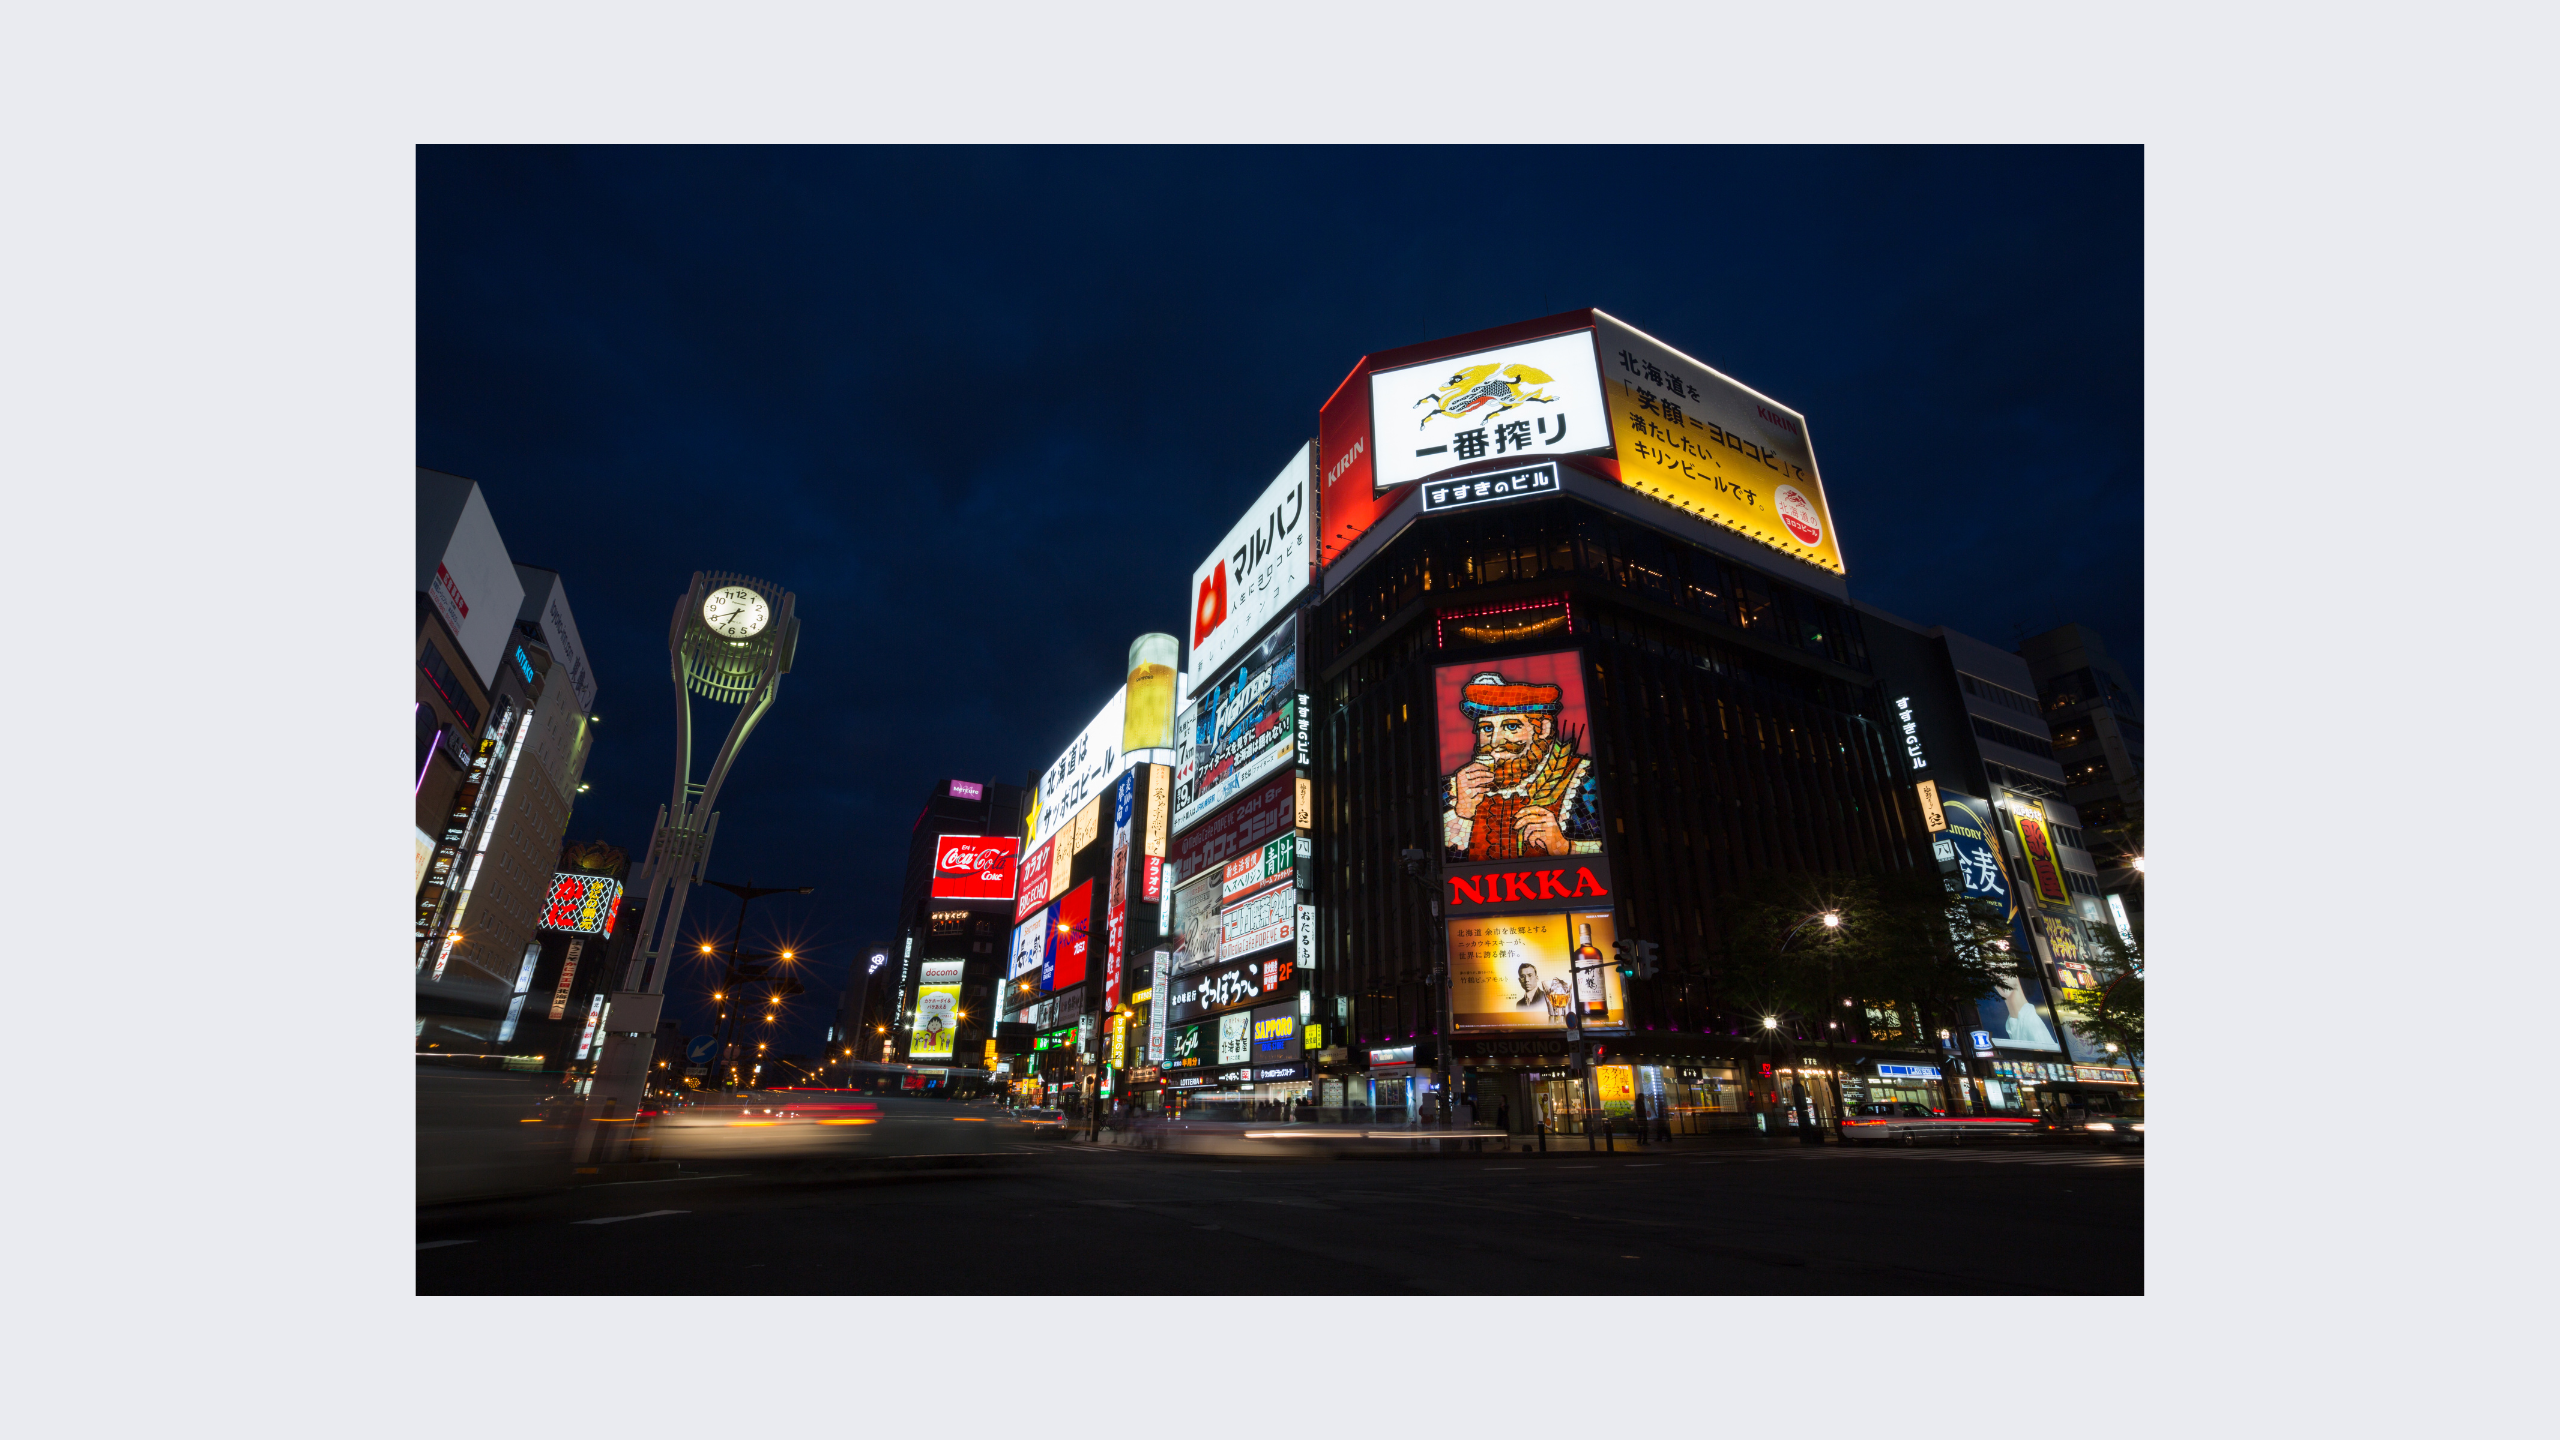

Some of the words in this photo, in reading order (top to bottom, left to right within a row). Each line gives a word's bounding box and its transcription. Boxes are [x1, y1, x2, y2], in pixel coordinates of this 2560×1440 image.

[1619, 349, 1700, 403] 北海道を
[1756, 404, 1798, 436] KIRIN
[1415, 412, 1568, 461] 一番搾り
[1629, 411, 1721, 468] 満たしたい、
[1327, 436, 1364, 488] KIRIN
[1431, 471, 1549, 504] すすきのビル
[1635, 440, 1765, 512] キリンビールです。
[1778, 501, 1818, 527] 北海道の
[1232, 480, 1303, 586] マルハン
[1231, 533, 1303, 614] 人生にヨロコビを
[709, 604, 717, 612] 9
[715, 596, 726, 605] 10
[724, 591, 734, 600] 11
[736, 590, 748, 600] 12
[755, 604, 762, 612] 2
[710, 614, 718, 622] 8
[719, 622, 726, 630] 7
[728, 627, 736, 635] 6
[740, 627, 748, 635] 5
[750, 622, 757, 630] 4
[1210, 663, 1274, 757] FIGHTERS
[1297, 693, 1310, 766] すすきのビル
[1895, 696, 1927, 770] すすきのビル
[1046, 732, 1089, 798] 北海道は
[1198, 726, 1257, 779] ファイターズを見ずに
[953, 785, 979, 795] Mercure
[1043, 745, 1115, 835] サッポロビール
[1236, 796, 1262, 822] 24H
[1264, 786, 1283, 805] 8F
[1173, 830, 1238, 881] ネットカフェ
[1238, 794, 1294, 849] コミック
[1945, 823, 1982, 841] UNTORY
[941, 847, 1009, 870] Coca-Cola
[1023, 846, 1050, 882] カラオケ
[1225, 851, 1258, 879] 新生活習慣
[1265, 842, 1294, 876] 青汁
[981, 870, 1003, 881] Coke
[1147, 856, 1161, 895] カラオケ
[1224, 868, 1263, 893] ヘスペリジン
[1447, 866, 1609, 906] NIKKA
[548, 876, 585, 928] かに
[1270, 887, 1295, 924] 24H
[1254, 928, 1278, 948] POPEYE
[1456, 928, 1483, 938] 北海道
[1484, 925, 1548, 937] 余市を故郷とする
[1458, 949, 1522, 960] 世界に誇る傑作。
[925, 968, 959, 977] docomo
[1279, 961, 1294, 982] 2F
[1254, 1015, 1294, 1042] SAPPORO
[1174, 1031, 1199, 1057] エイブル
[1476, 1041, 1562, 1055] SUSUKINO
[1180, 1077, 1200, 1087] LOTTERIA
[1602, 1068, 1611, 1098] スクエア
[1611, 1067, 1622, 1097] タイムズ
[1910, 1066, 1933, 1076] LAWSON
